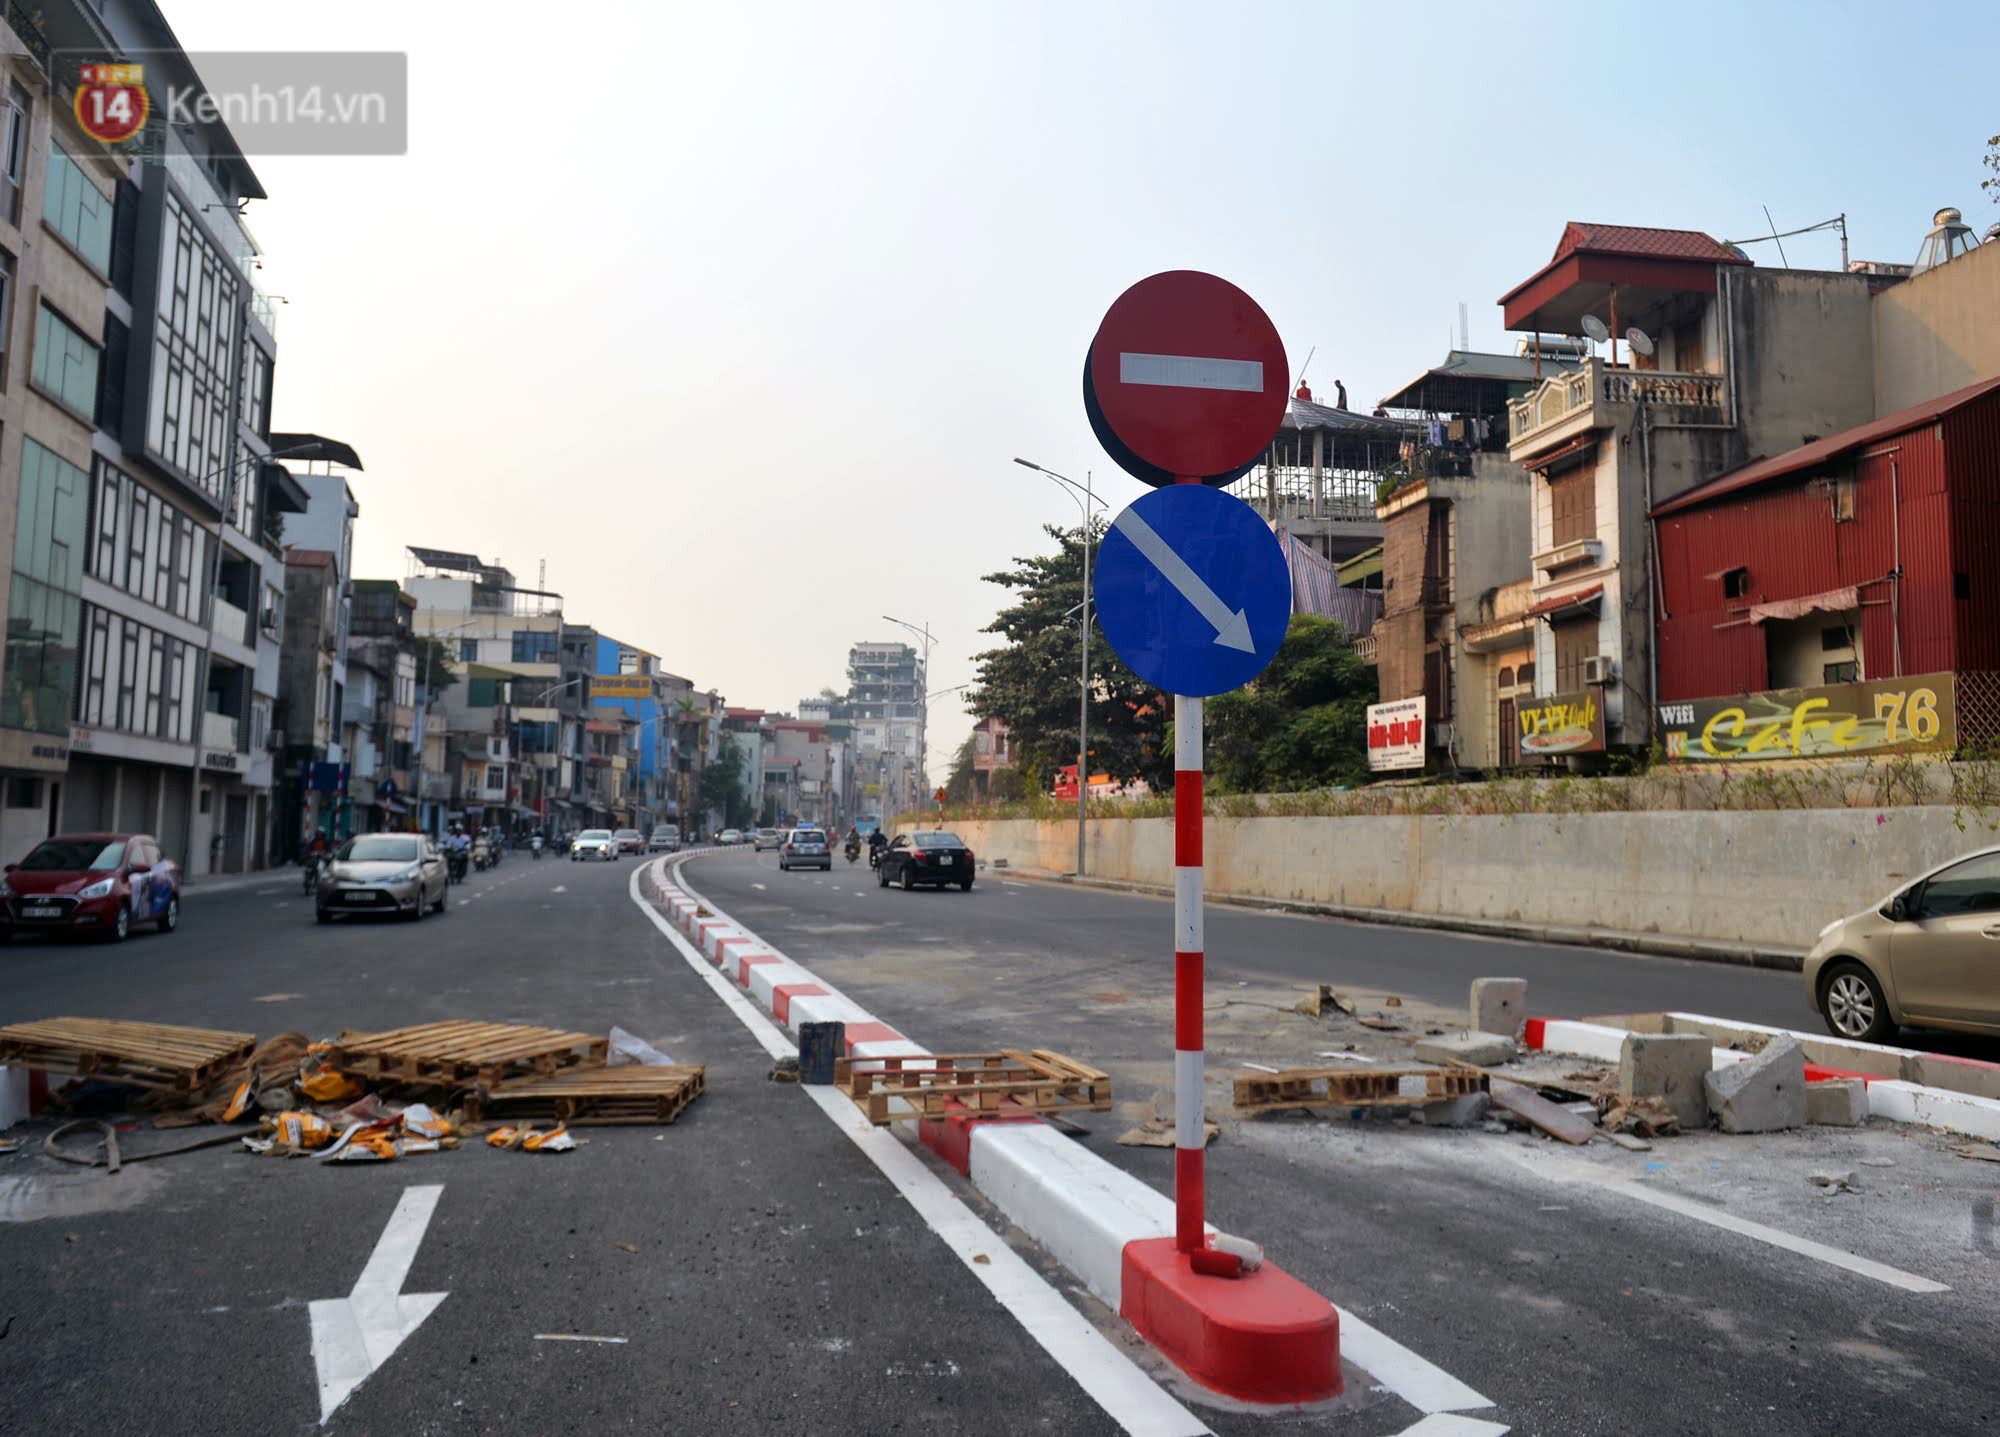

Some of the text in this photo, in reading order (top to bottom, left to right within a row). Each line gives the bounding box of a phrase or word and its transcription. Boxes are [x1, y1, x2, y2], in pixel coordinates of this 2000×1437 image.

[1519, 708, 1542, 736] VY
[1544, 703, 1569, 733] VY
[1659, 704, 1696, 726] Wifi
[1873, 687, 1941, 743] 76
